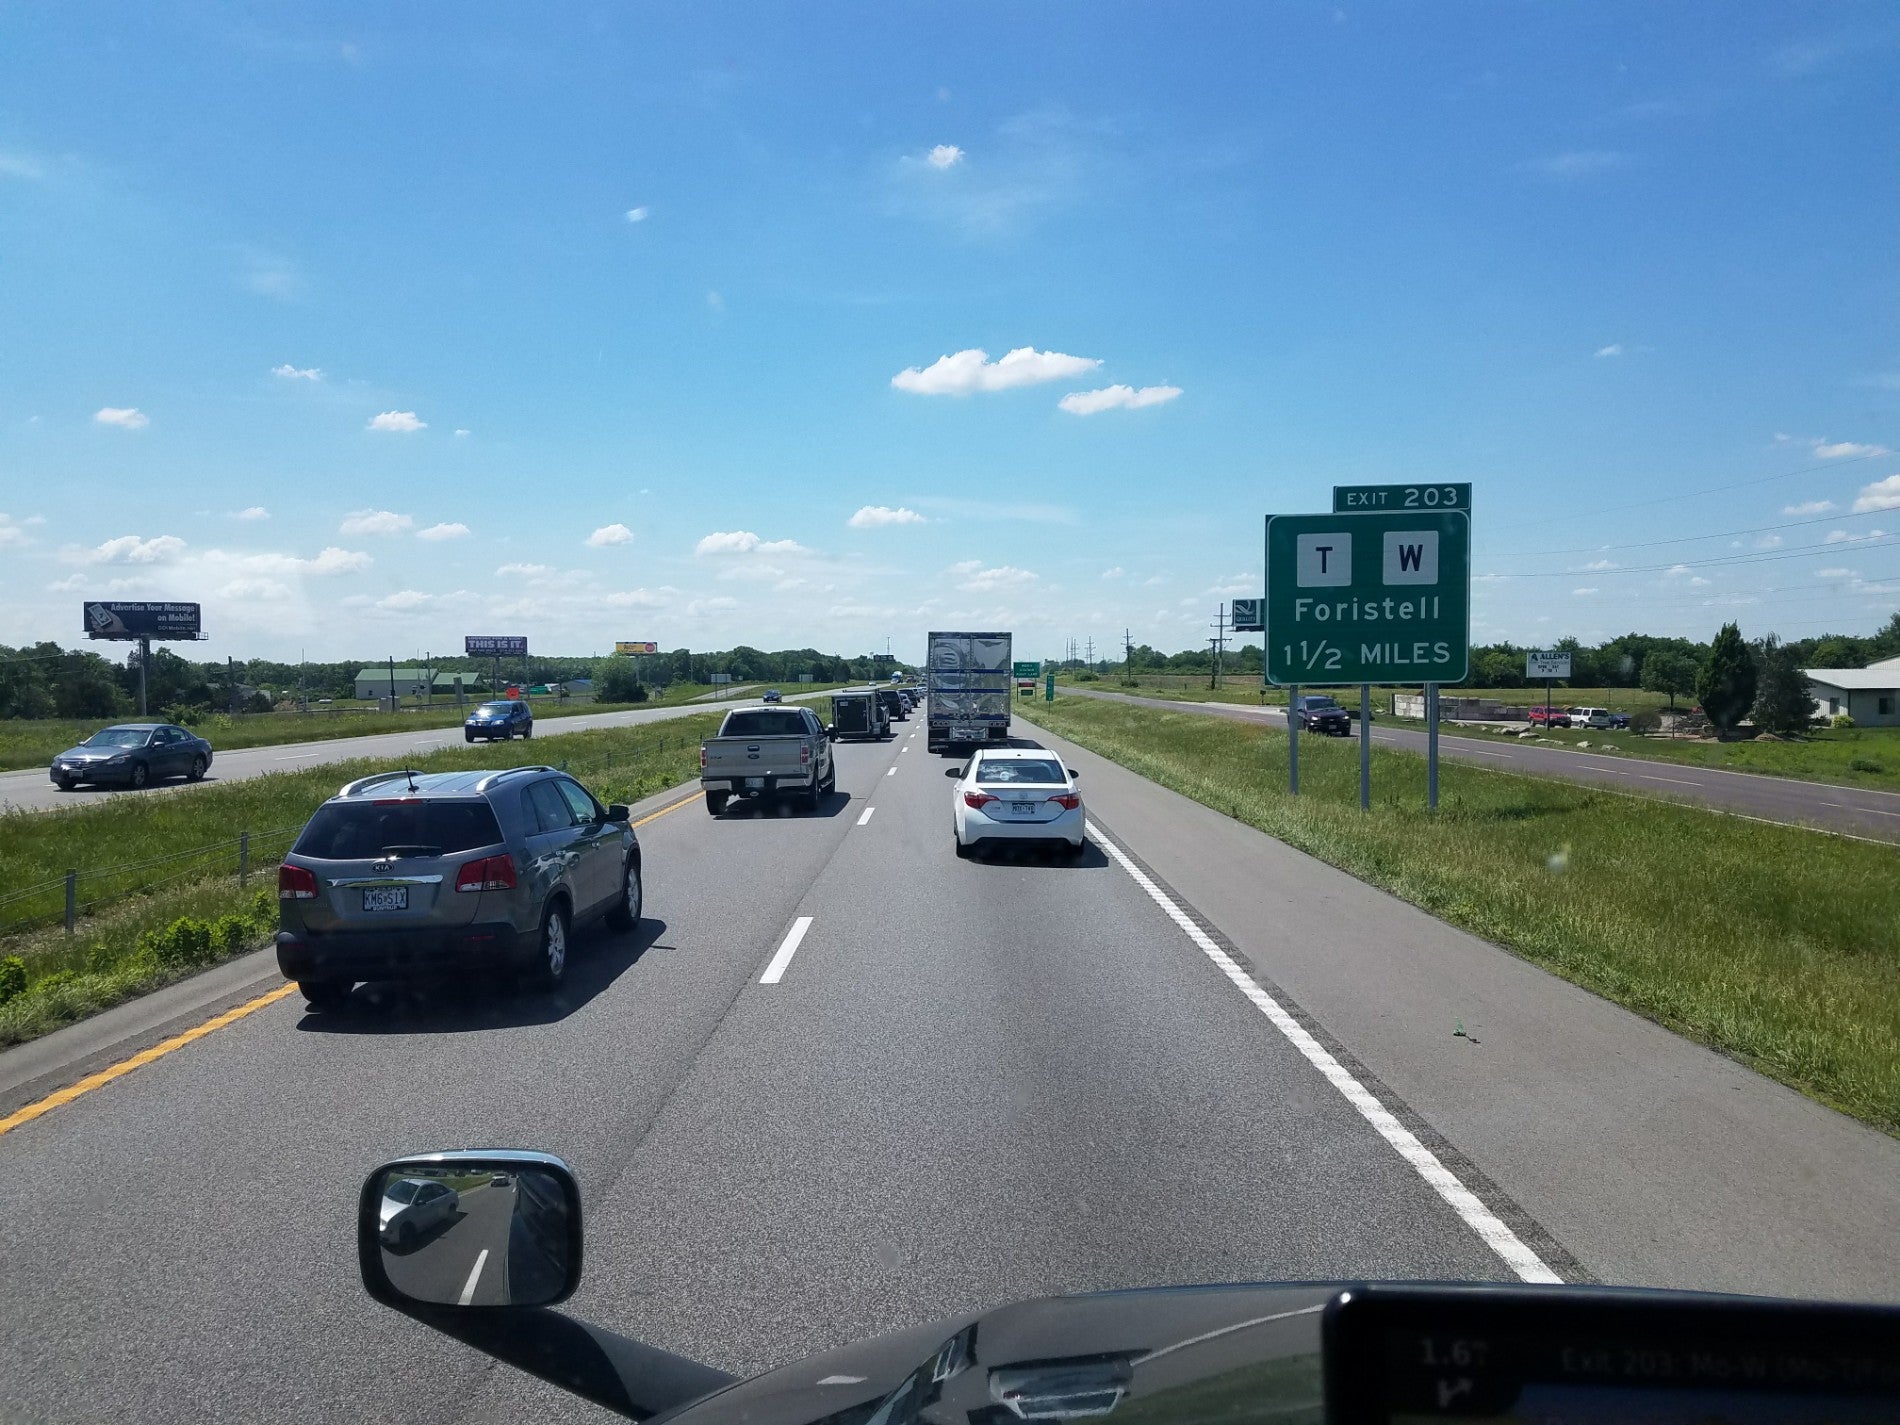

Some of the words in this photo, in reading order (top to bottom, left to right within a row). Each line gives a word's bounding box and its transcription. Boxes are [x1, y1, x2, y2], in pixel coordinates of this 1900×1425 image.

[1347, 492, 1389, 505] EXIT
[1404, 487, 1458, 507] 203
[1315, 546, 1334, 574] T
[1398, 544, 1424, 572] W
[110, 603, 144, 611] Advertise
[146, 603, 162, 611] Your
[163, 603, 195, 613] Message
[157, 614, 167, 622] on
[1295, 596, 1439, 622] Foristell
[1361, 642, 1451, 664] MILES
